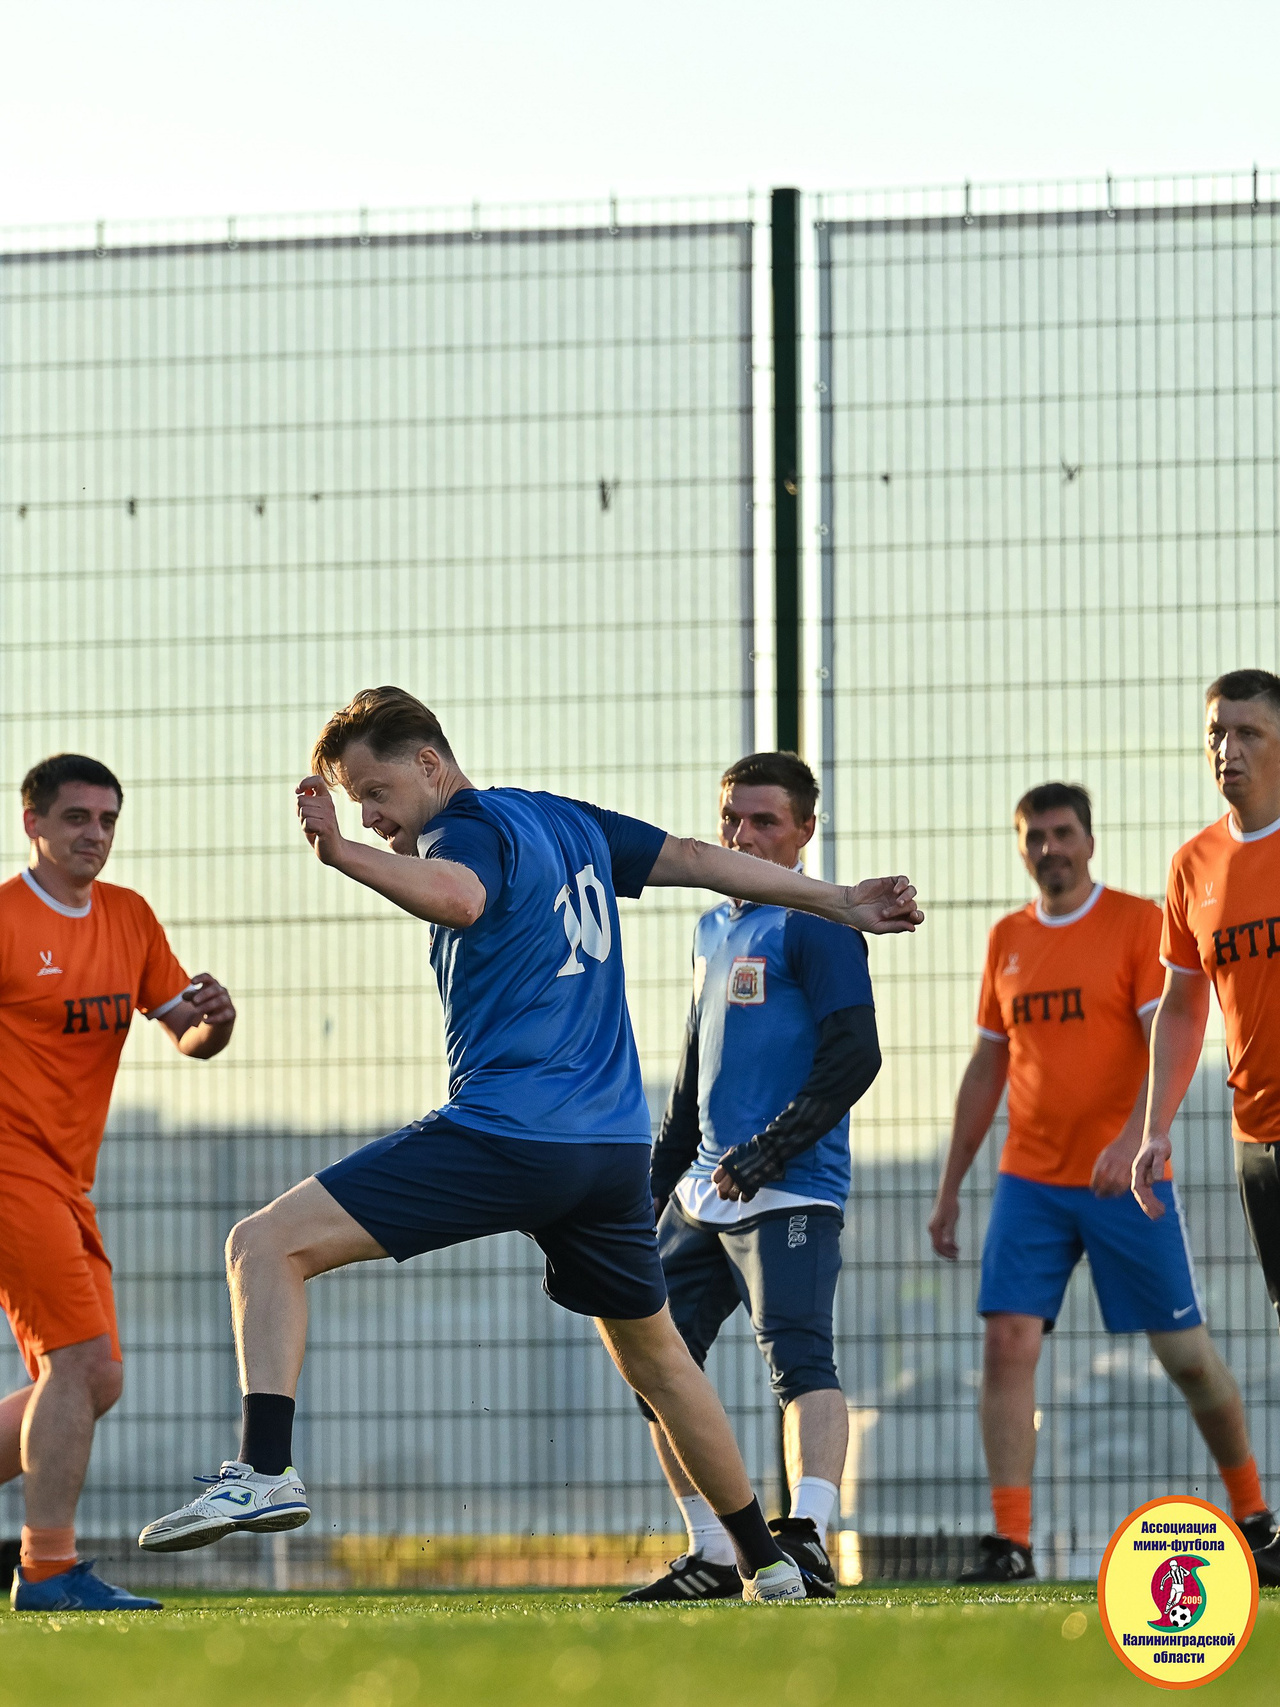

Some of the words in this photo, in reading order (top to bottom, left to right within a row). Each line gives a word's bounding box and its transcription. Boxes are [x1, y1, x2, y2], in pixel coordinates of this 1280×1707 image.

[553, 863, 612, 978] 10
[62, 993, 132, 1035] НТД
[1012, 986, 1085, 1025] НТД
